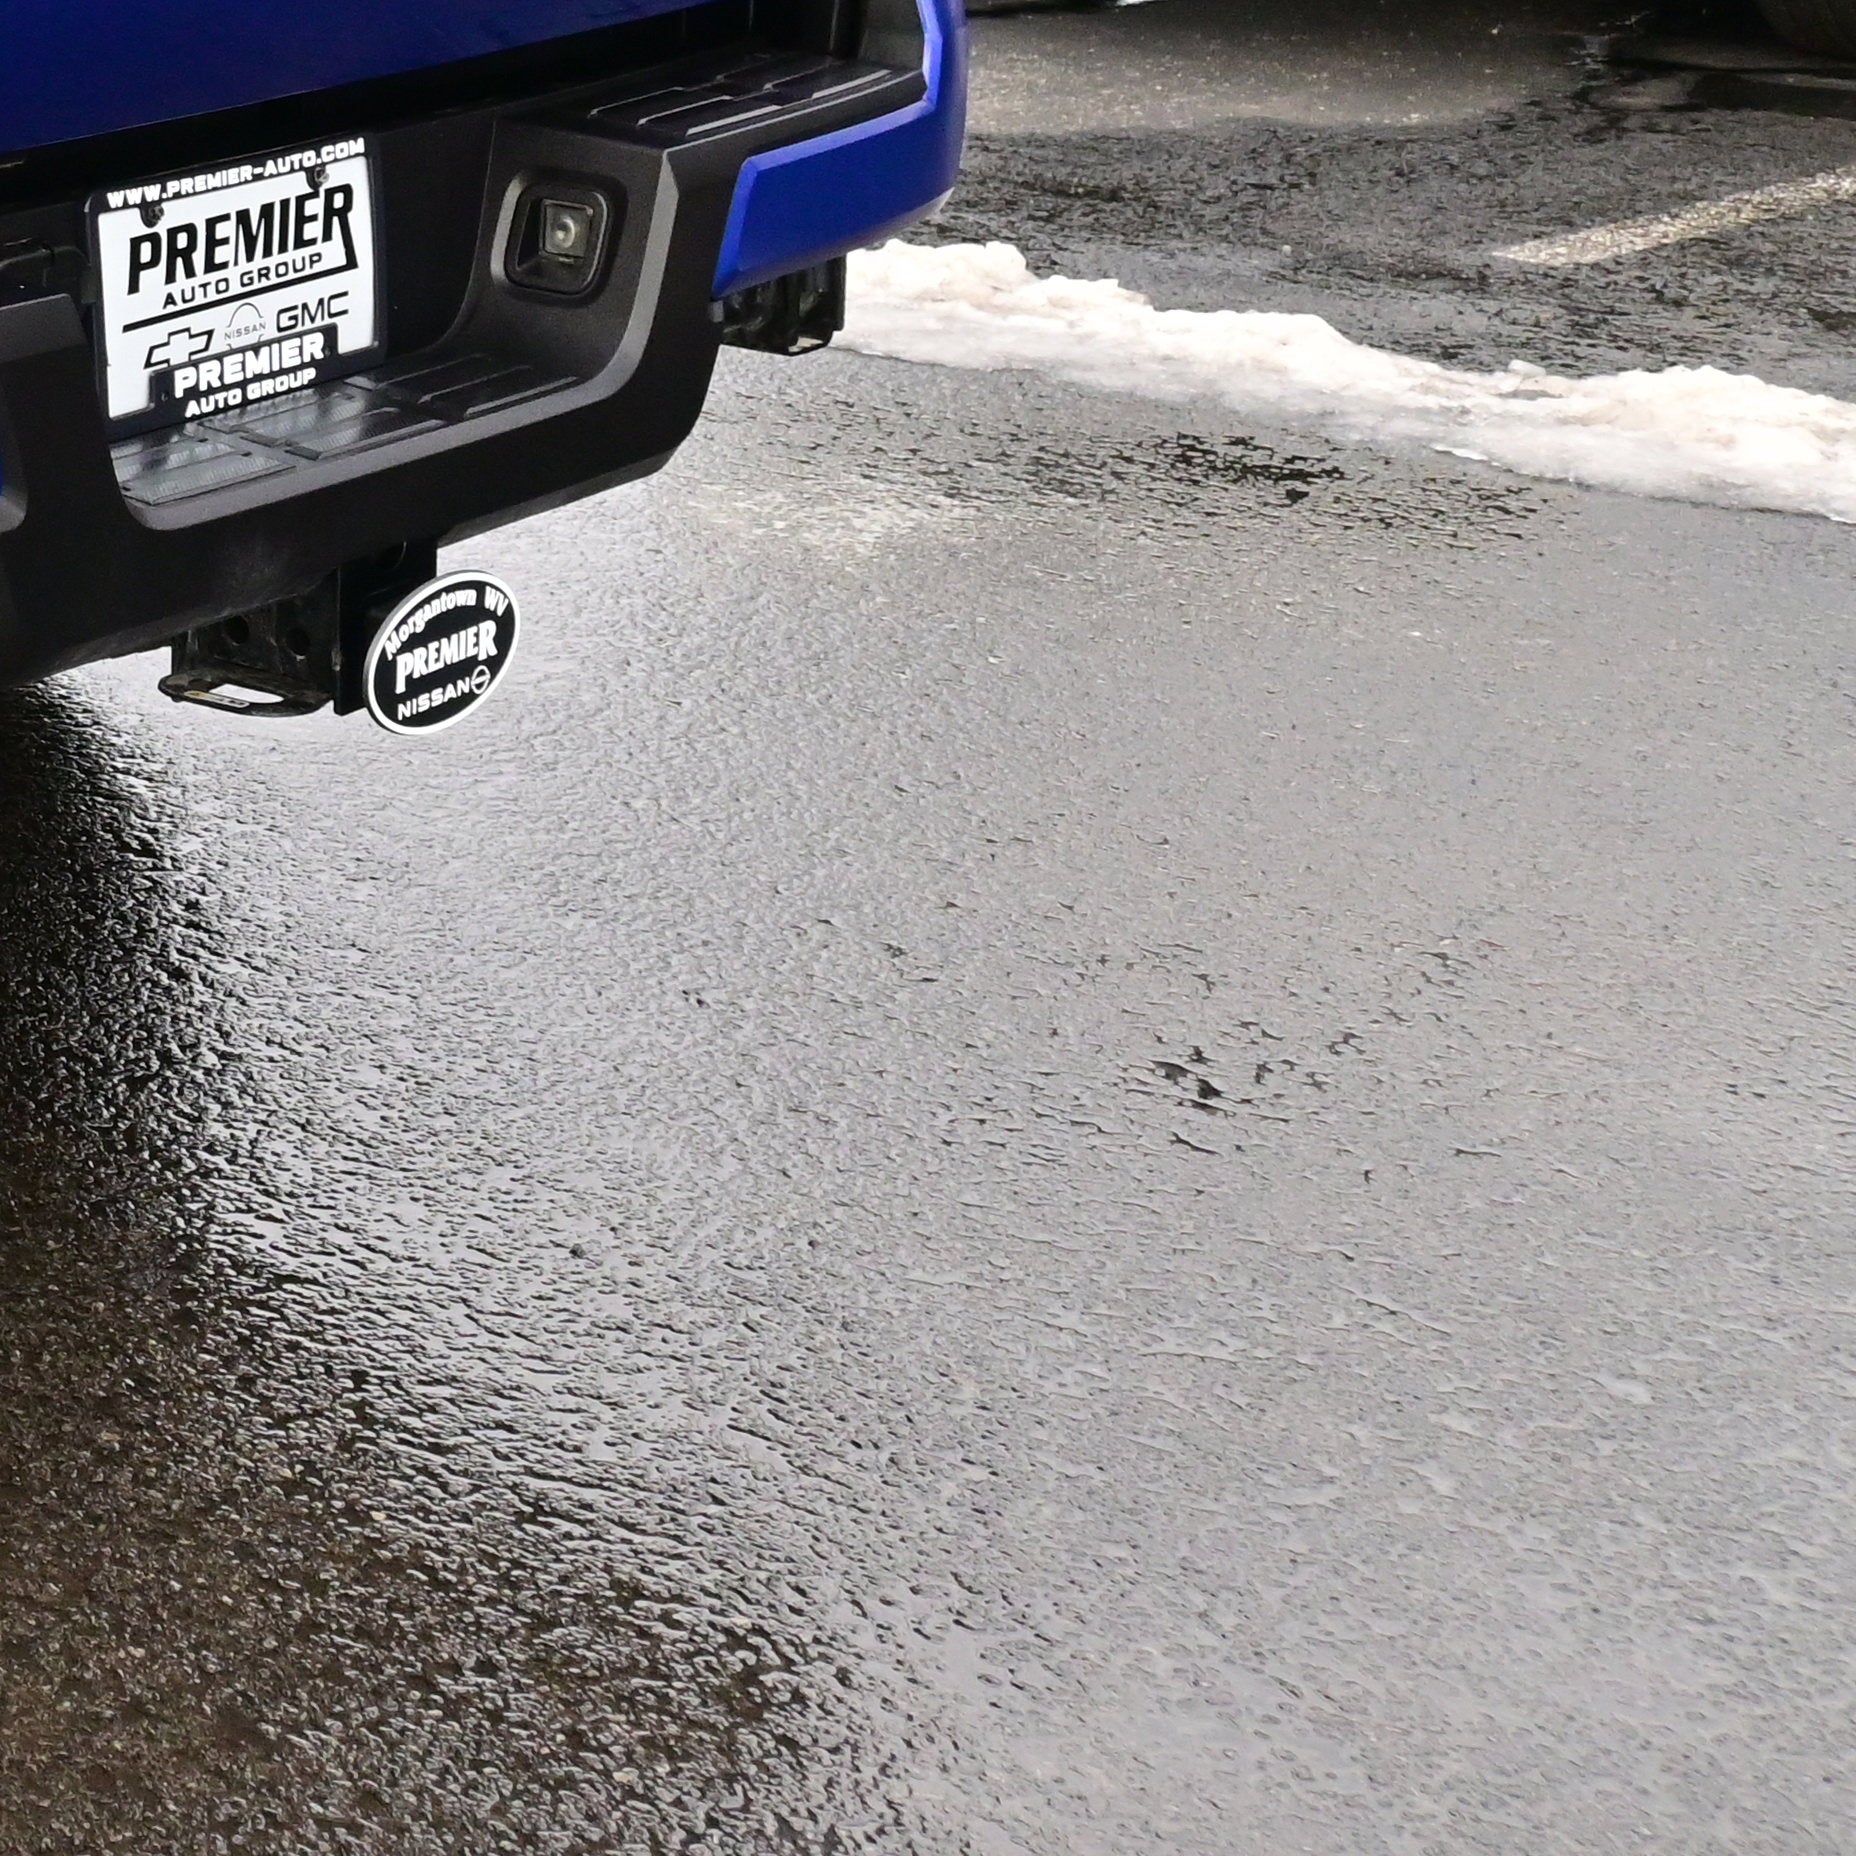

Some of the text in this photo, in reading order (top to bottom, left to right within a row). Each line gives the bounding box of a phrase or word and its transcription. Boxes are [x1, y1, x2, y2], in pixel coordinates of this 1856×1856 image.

[107, 138, 365, 209] WWW.PREMIER-AUTO.COM
[127, 183, 359, 295] PREMIER
[163, 252, 323, 310] AUTO GROUP
[224, 291, 349, 341] NISSAN GMC
[174, 332, 324, 398] PREMIER
[185, 367, 317, 418] AUTO GROUP
[385, 586, 509, 661] Morgantown WV
[395, 620, 498, 694] PREMIER
[398, 677, 470, 721] NISSAN
